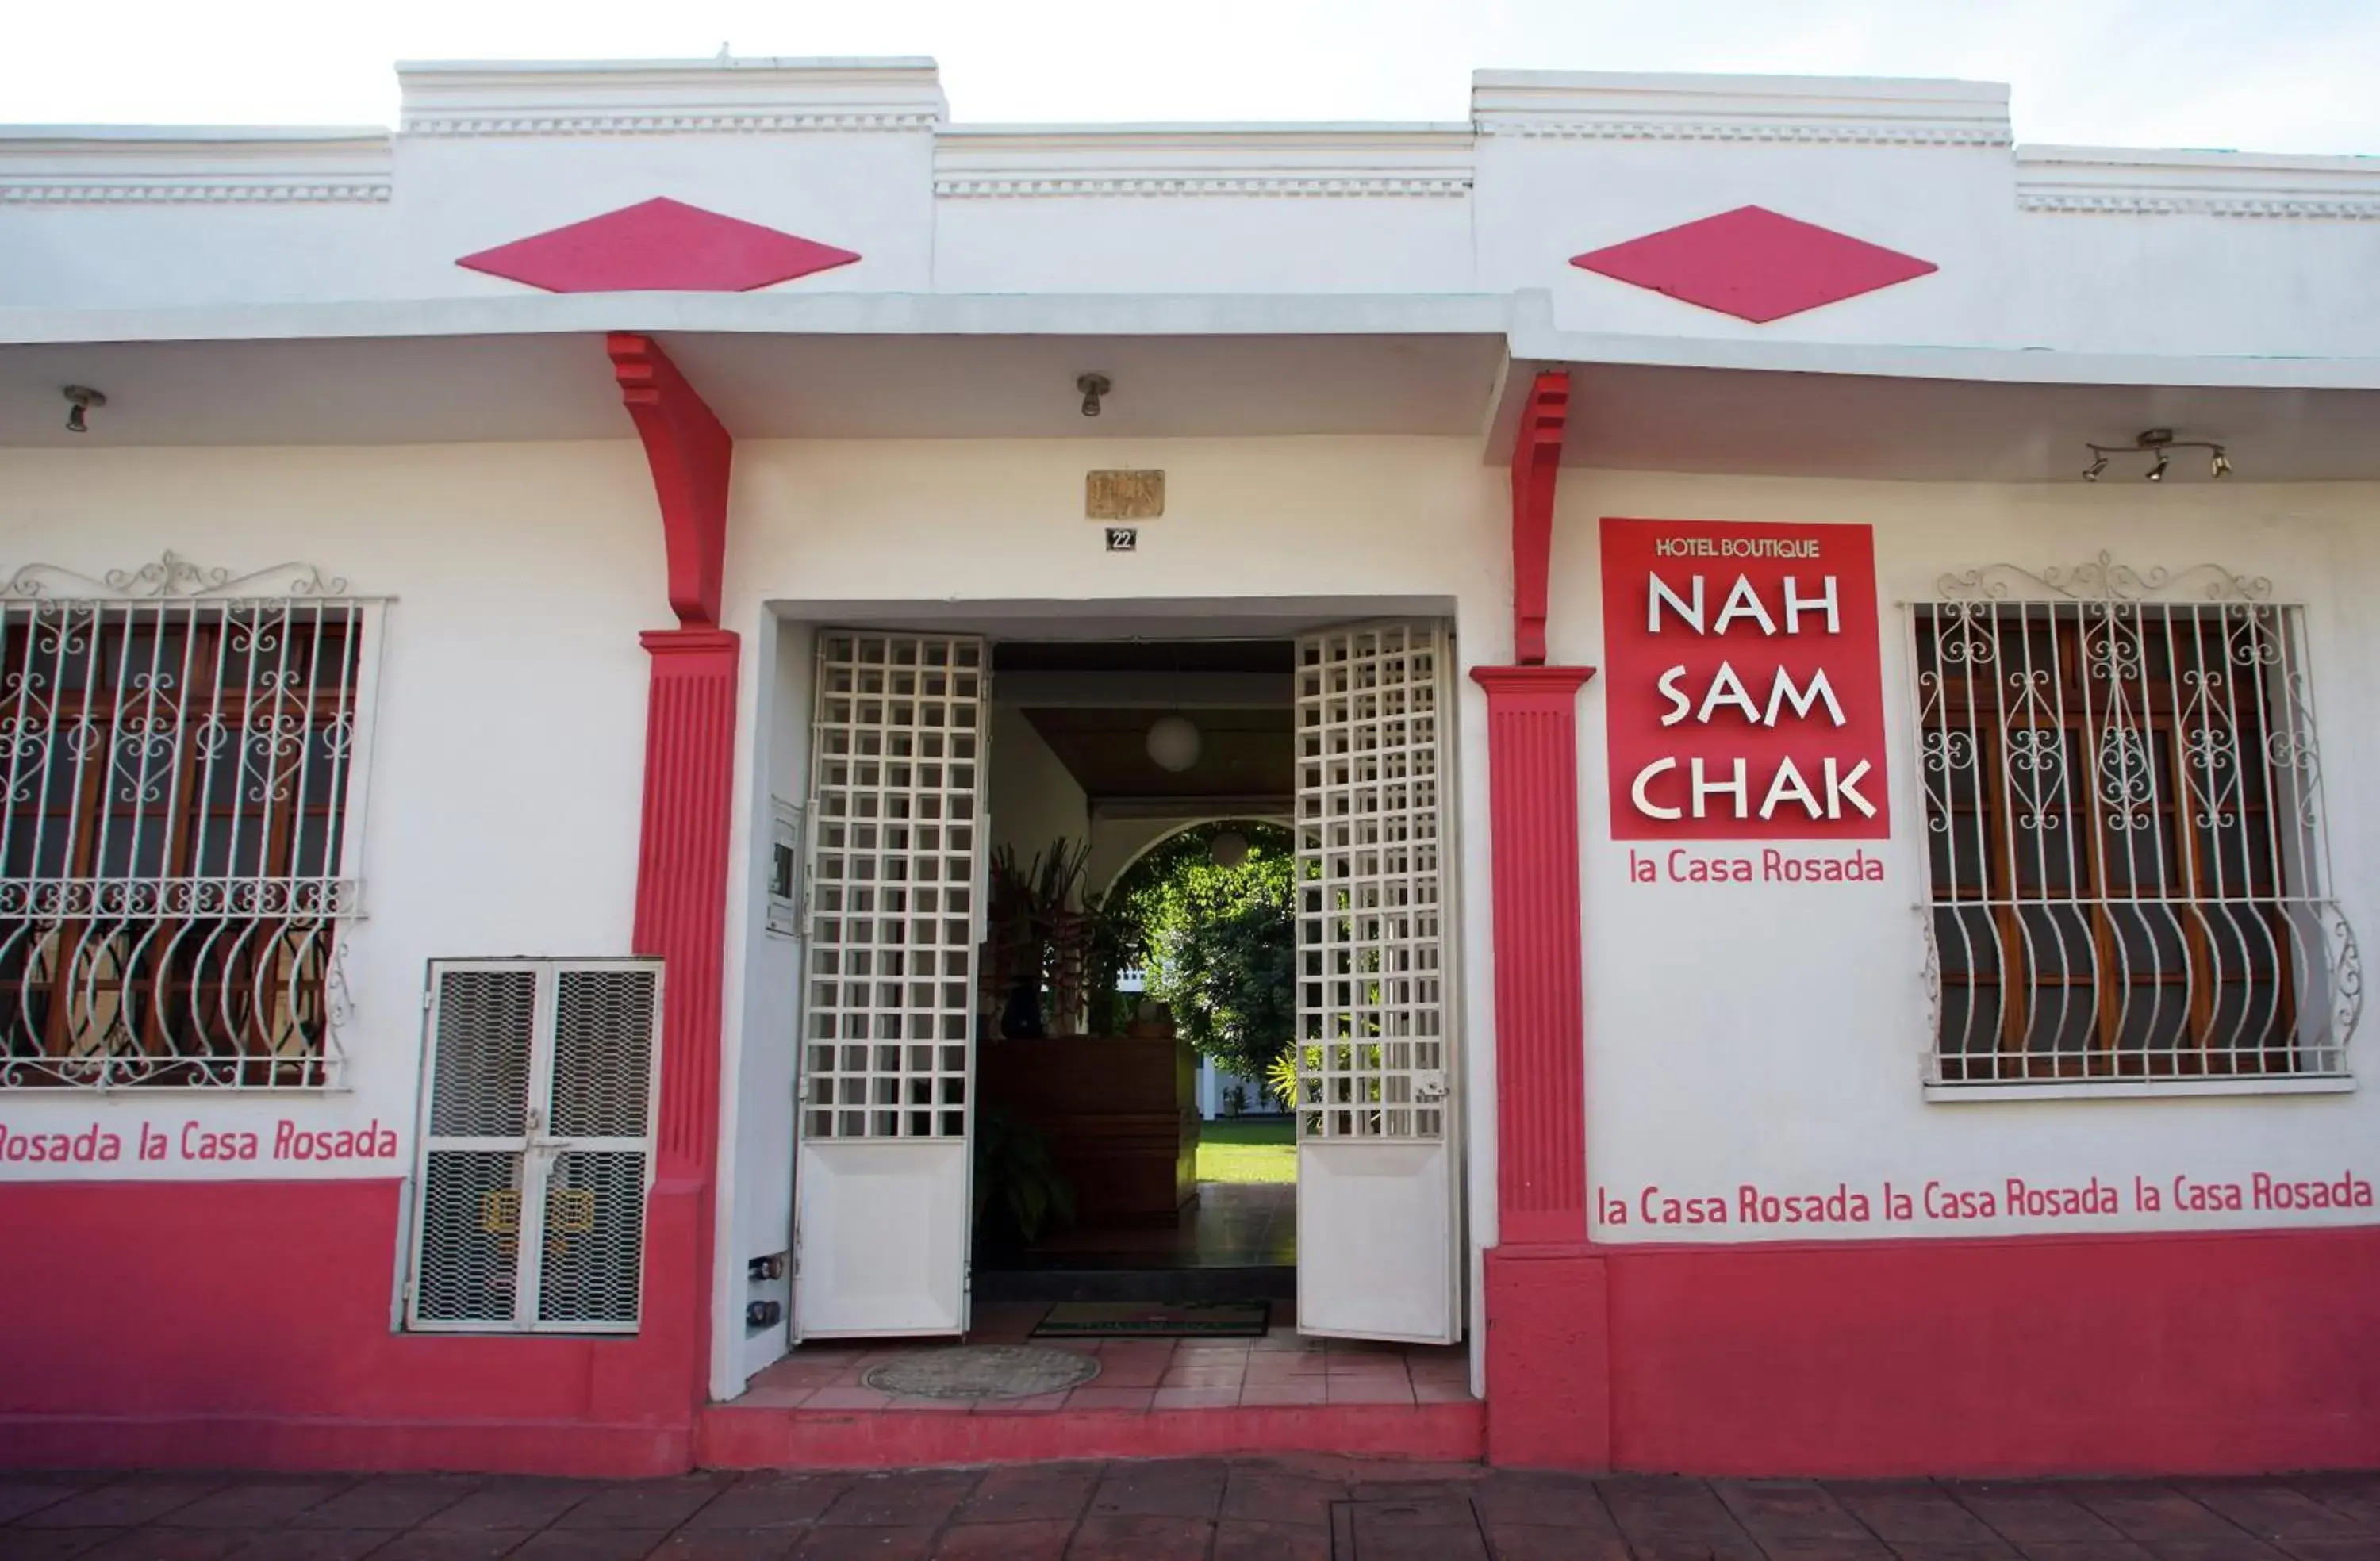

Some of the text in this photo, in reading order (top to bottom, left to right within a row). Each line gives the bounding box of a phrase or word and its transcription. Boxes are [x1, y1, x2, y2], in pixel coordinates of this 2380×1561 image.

[1112, 531, 1131, 548] 22
[1656, 538, 1821, 558] HOTEL BOUTIQUE
[1649, 571, 1840, 635] NAH
[1658, 661, 1846, 727] SAM
[1632, 756, 1877, 820] CHAK
[1630, 848, 1884, 883] la Casa Rosada
[139, 1121, 168, 1162] la
[182, 1120, 258, 1162] Casa
[274, 1118, 397, 1161] Rosada
[1598, 1170, 2373, 1224] la Casa Rosada la Casa Rosada la Casa Rosada
